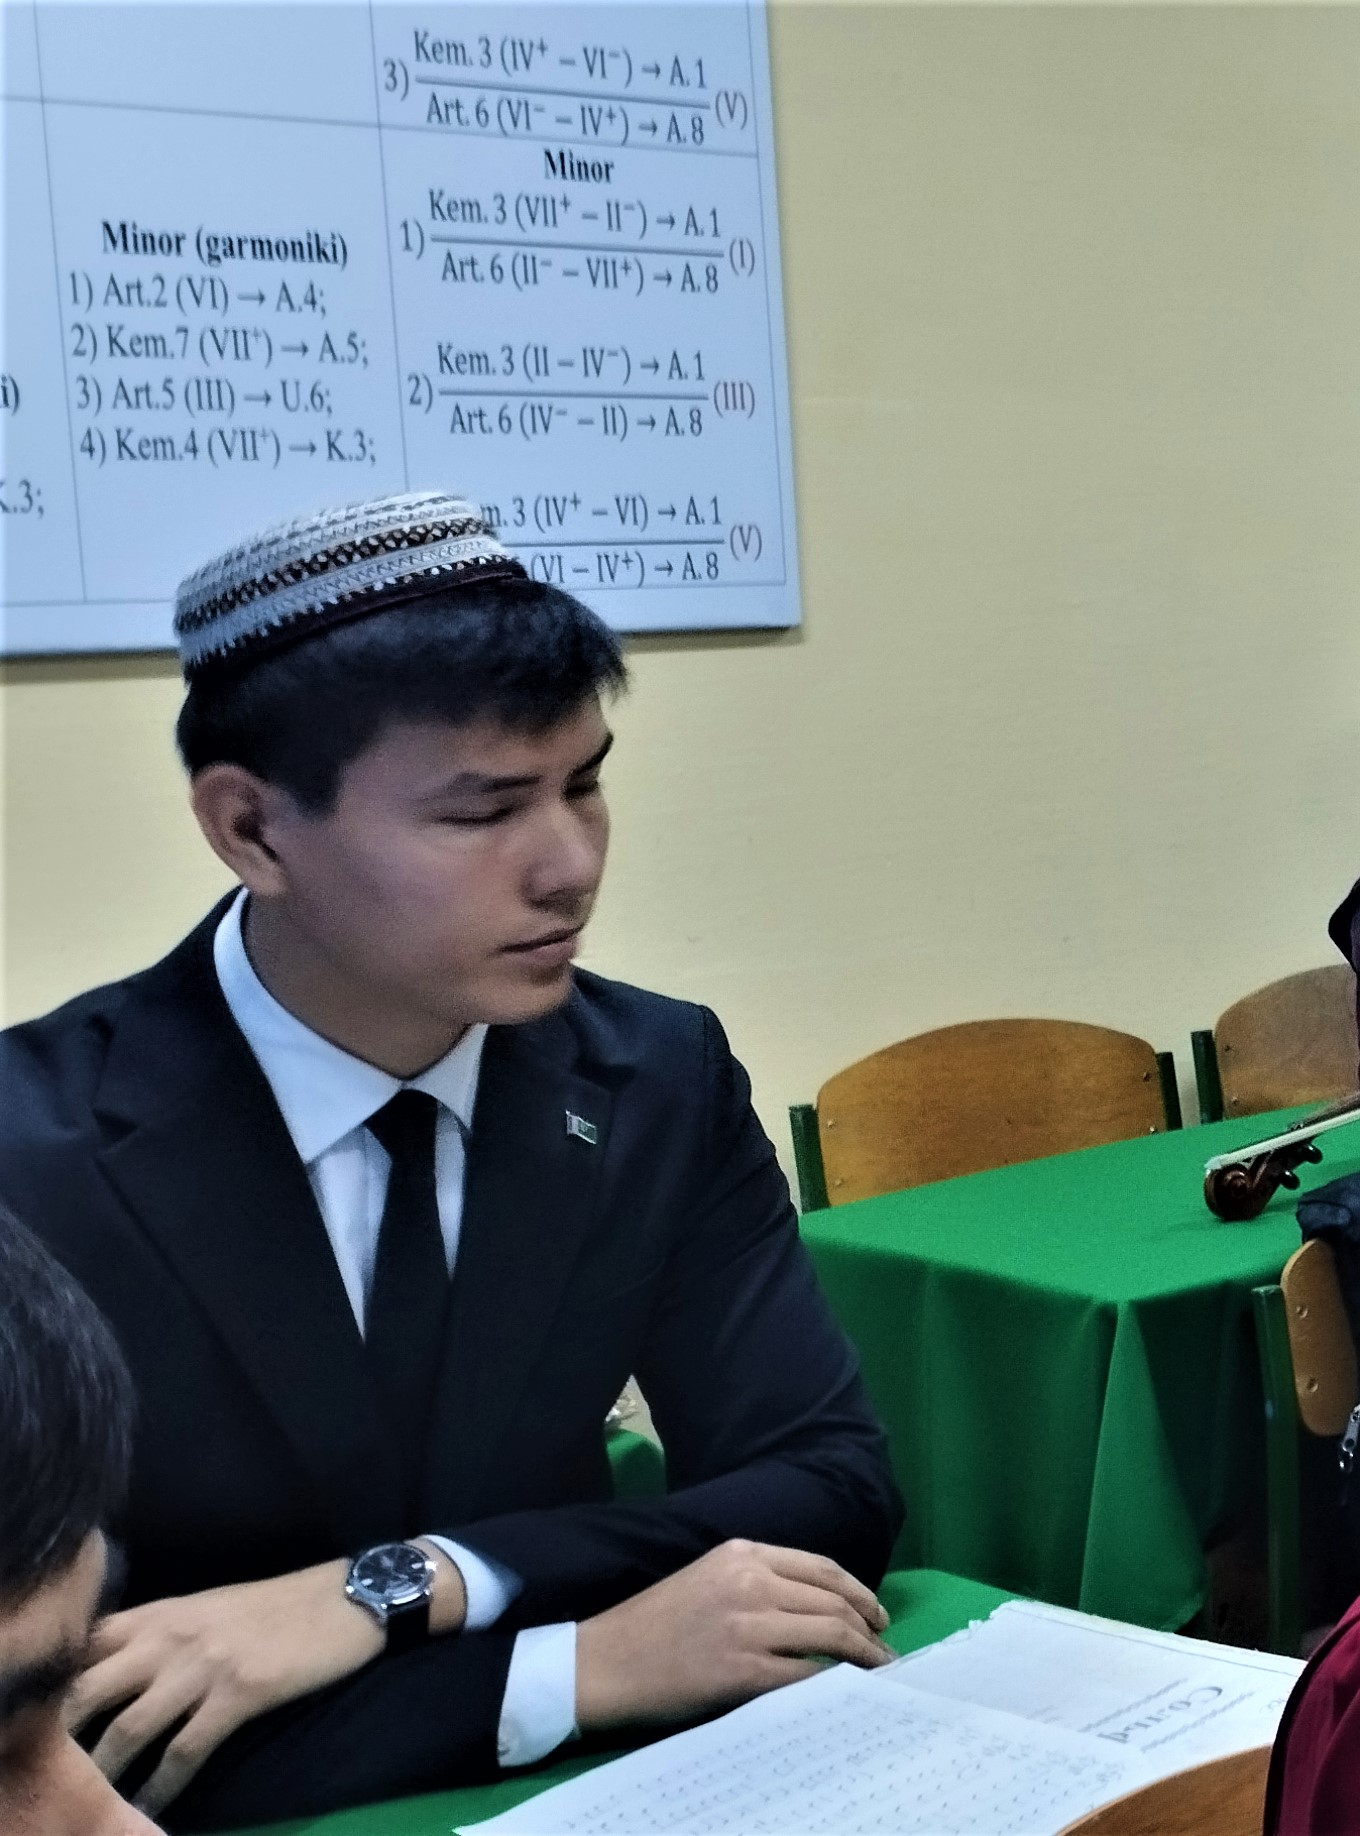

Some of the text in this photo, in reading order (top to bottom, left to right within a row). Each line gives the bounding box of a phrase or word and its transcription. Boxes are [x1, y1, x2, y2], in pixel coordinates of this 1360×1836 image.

[383, 57, 409, 101] 3)
[715, 88, 748, 131] (V)
[544, 149, 615, 184] Minor
[101, 219, 348, 271] Minor (garmoniki)
[399, 219, 425, 261] 1)
[729, 237, 755, 277] (I)
[71, 271, 93, 313] 1)
[176, 274, 229, 316] (VI)
[71, 322, 97, 366] 2)
[76, 374, 102, 417] 3)
[184, 376, 235, 418] (III)
[408, 373, 434, 415] 2)
[713, 380, 755, 419] (III)
[80, 425, 106, 469] 4)
[730, 523, 762, 562] (V)
